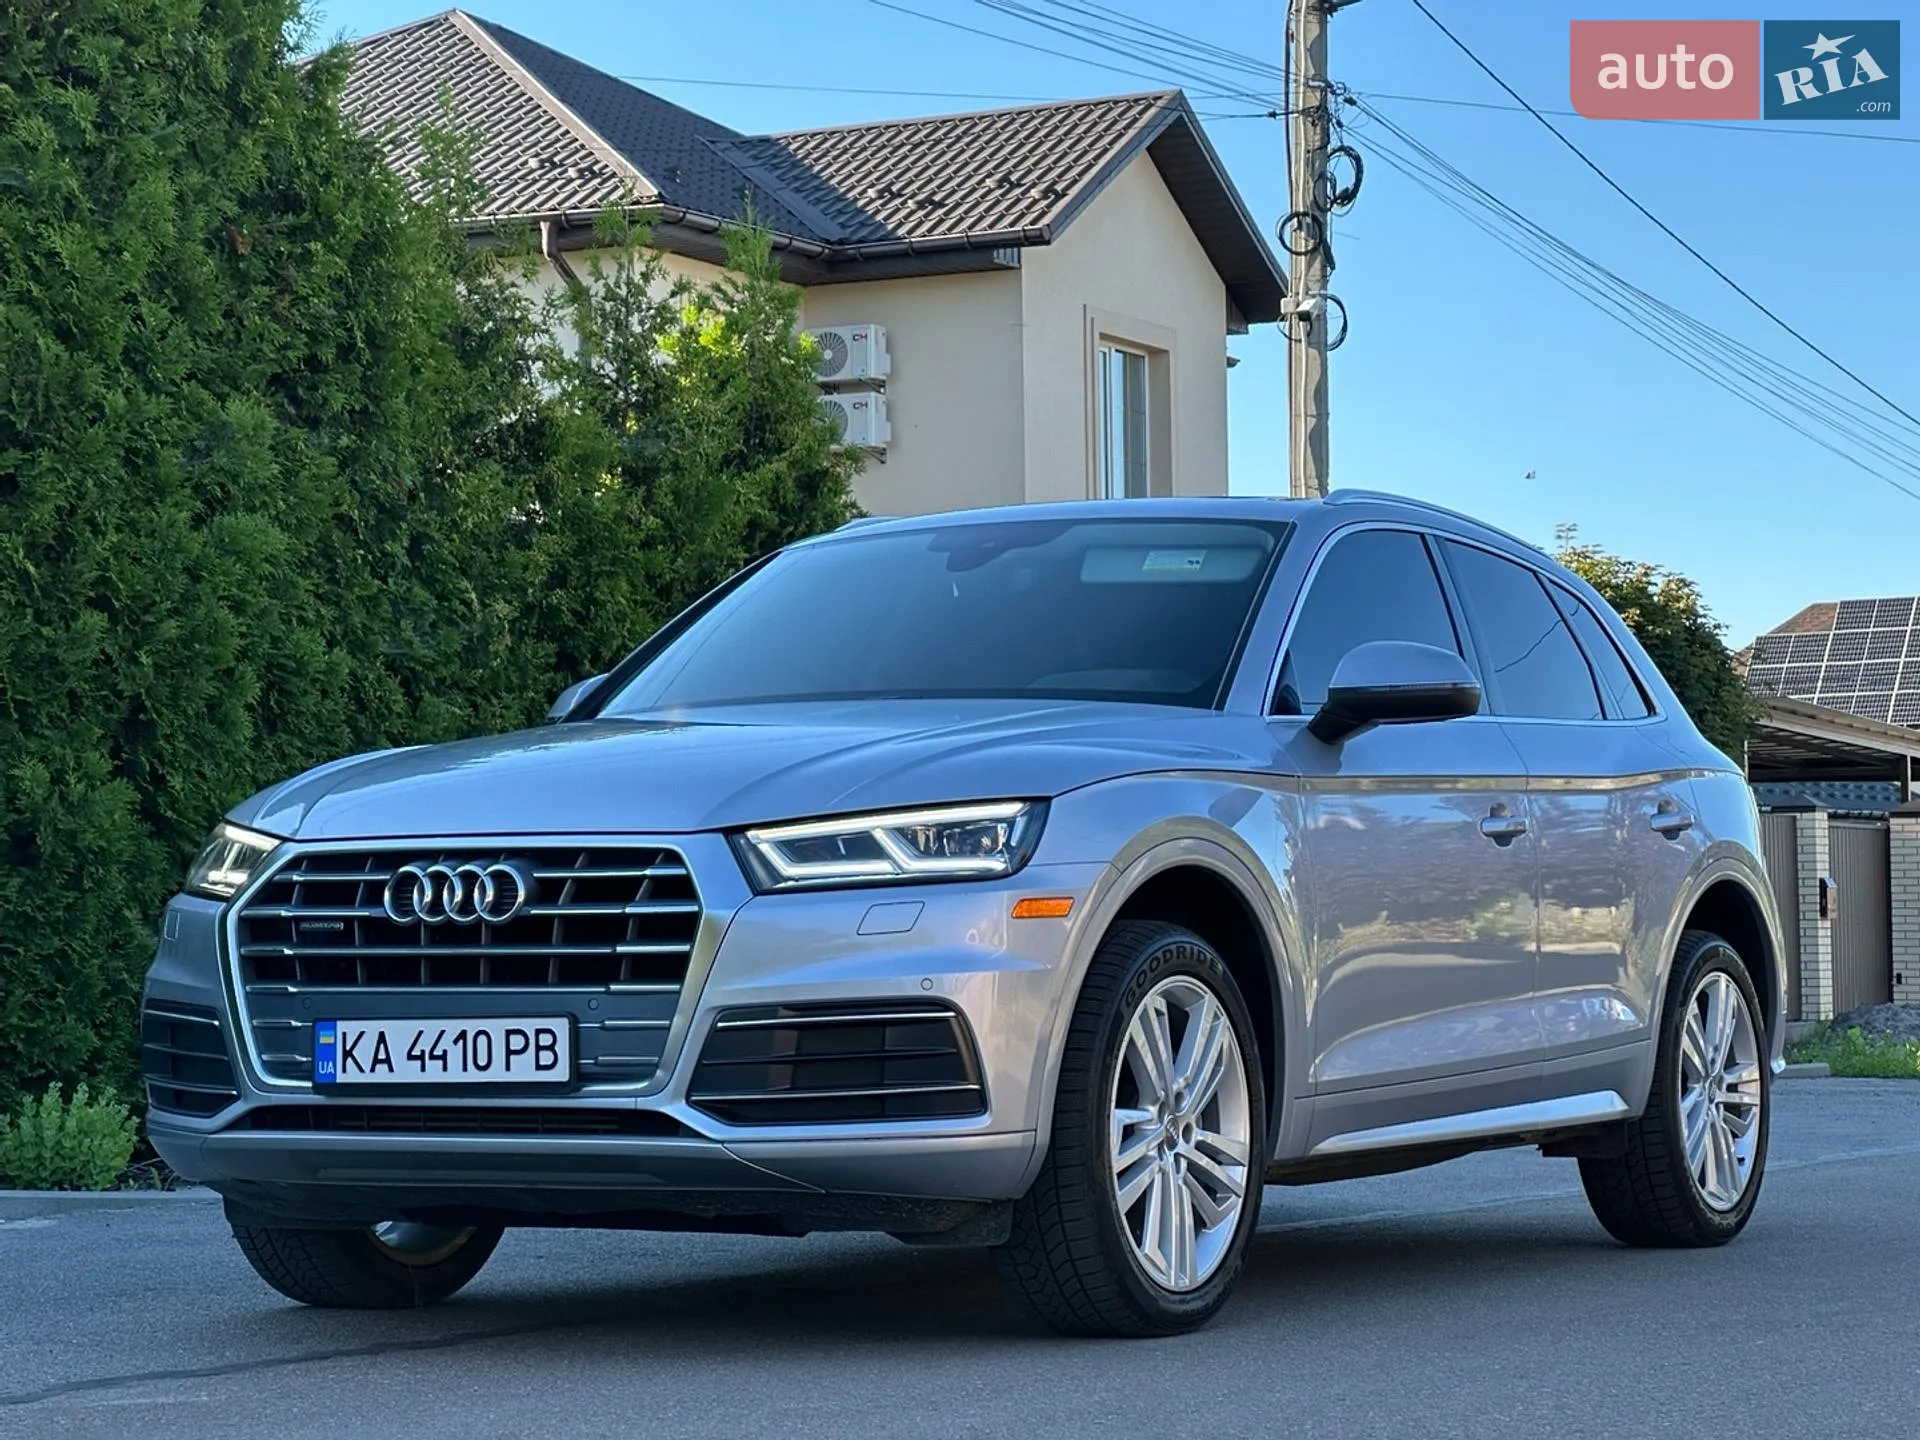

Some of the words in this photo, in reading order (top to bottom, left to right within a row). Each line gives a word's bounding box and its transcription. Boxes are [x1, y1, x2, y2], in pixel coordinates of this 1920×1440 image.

[1125, 944, 1221, 1009] GOODRIDE
[318, 1061, 335, 1075] UA
[341, 1030, 395, 1073] KA
[406, 1029, 493, 1073] 4410
[504, 1028, 559, 1072] PB
